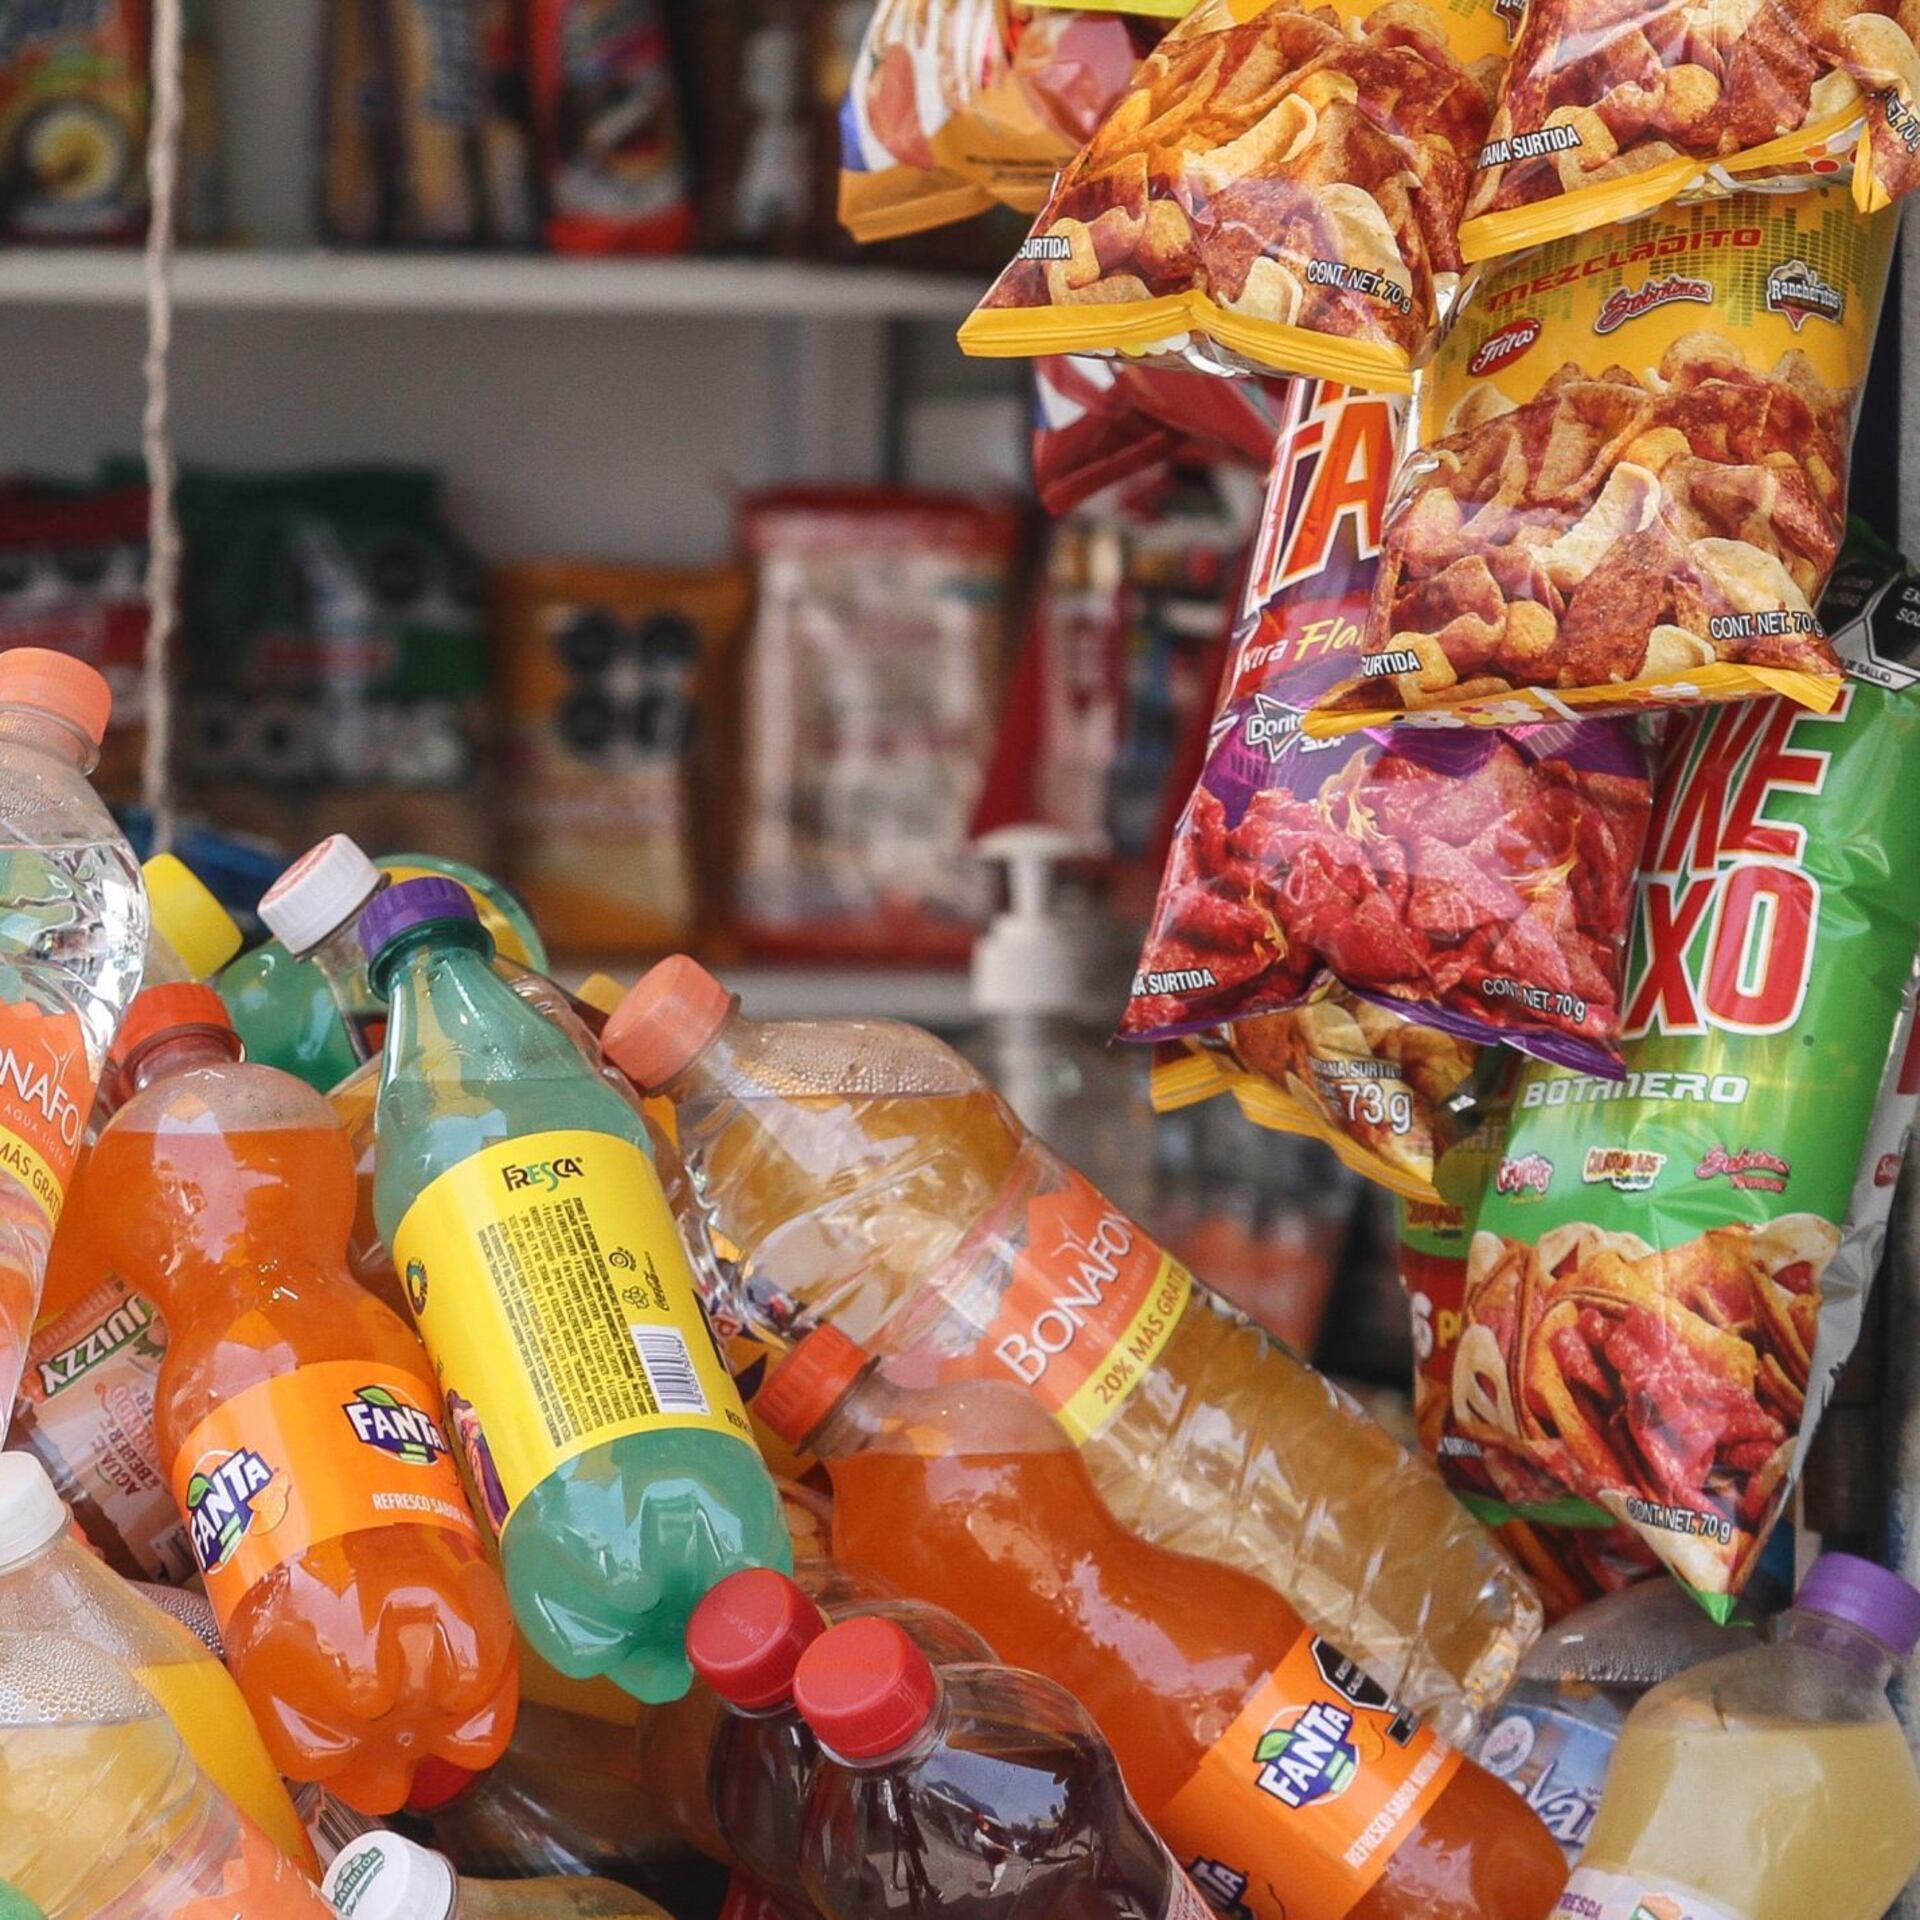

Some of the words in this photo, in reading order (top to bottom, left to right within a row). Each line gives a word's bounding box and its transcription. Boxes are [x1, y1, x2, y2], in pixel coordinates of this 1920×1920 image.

[1512, 125, 1580, 158] SURTIDA
[1307, 260, 1347, 288] CONT.
[1348, 270, 1382, 296] NET.
[1384, 282, 1403, 305] 70
[1402, 297, 1412, 314] g
[1488, 227, 1761, 312] MEZCLADITO
[1472, 326, 1535, 373] Fritos
[1710, 615, 1755, 639] CONT.
[1757, 612, 1791, 635] NET.
[1793, 612, 1812, 632] 70
[1251, 714, 1304, 739] Dorit
[1148, 968, 1217, 994] SURTIDA
[1523, 988, 1552, 1013] NET.
[1555, 994, 1572, 1016] 70
[1574, 1000, 1585, 1022] g
[1339, 1082, 1385, 1126] 73
[1389, 1091, 1412, 1135] g
[502, 1157, 584, 1192] FRESCA
[40, 1295, 148, 1393] JUIZZY
[1094, 1358, 1135, 1405] 20%
[1128, 1311, 1164, 1362] MÁS
[346, 1402, 447, 1452] FANTA
[101, 1451, 141, 1496] AGUA
[190, 1447, 272, 1557] FANTA
[372, 1493, 431, 1512] REFRESCO
[1665, 1508, 1695, 1533] NET.
[1700, 1513, 1718, 1535] 70
[1720, 1522, 1731, 1544] g
[1257, 1703, 1351, 1808] FANTA
[1342, 1809, 1397, 1870] REFRESCO
[335, 1850, 379, 1908] JARRITOS
